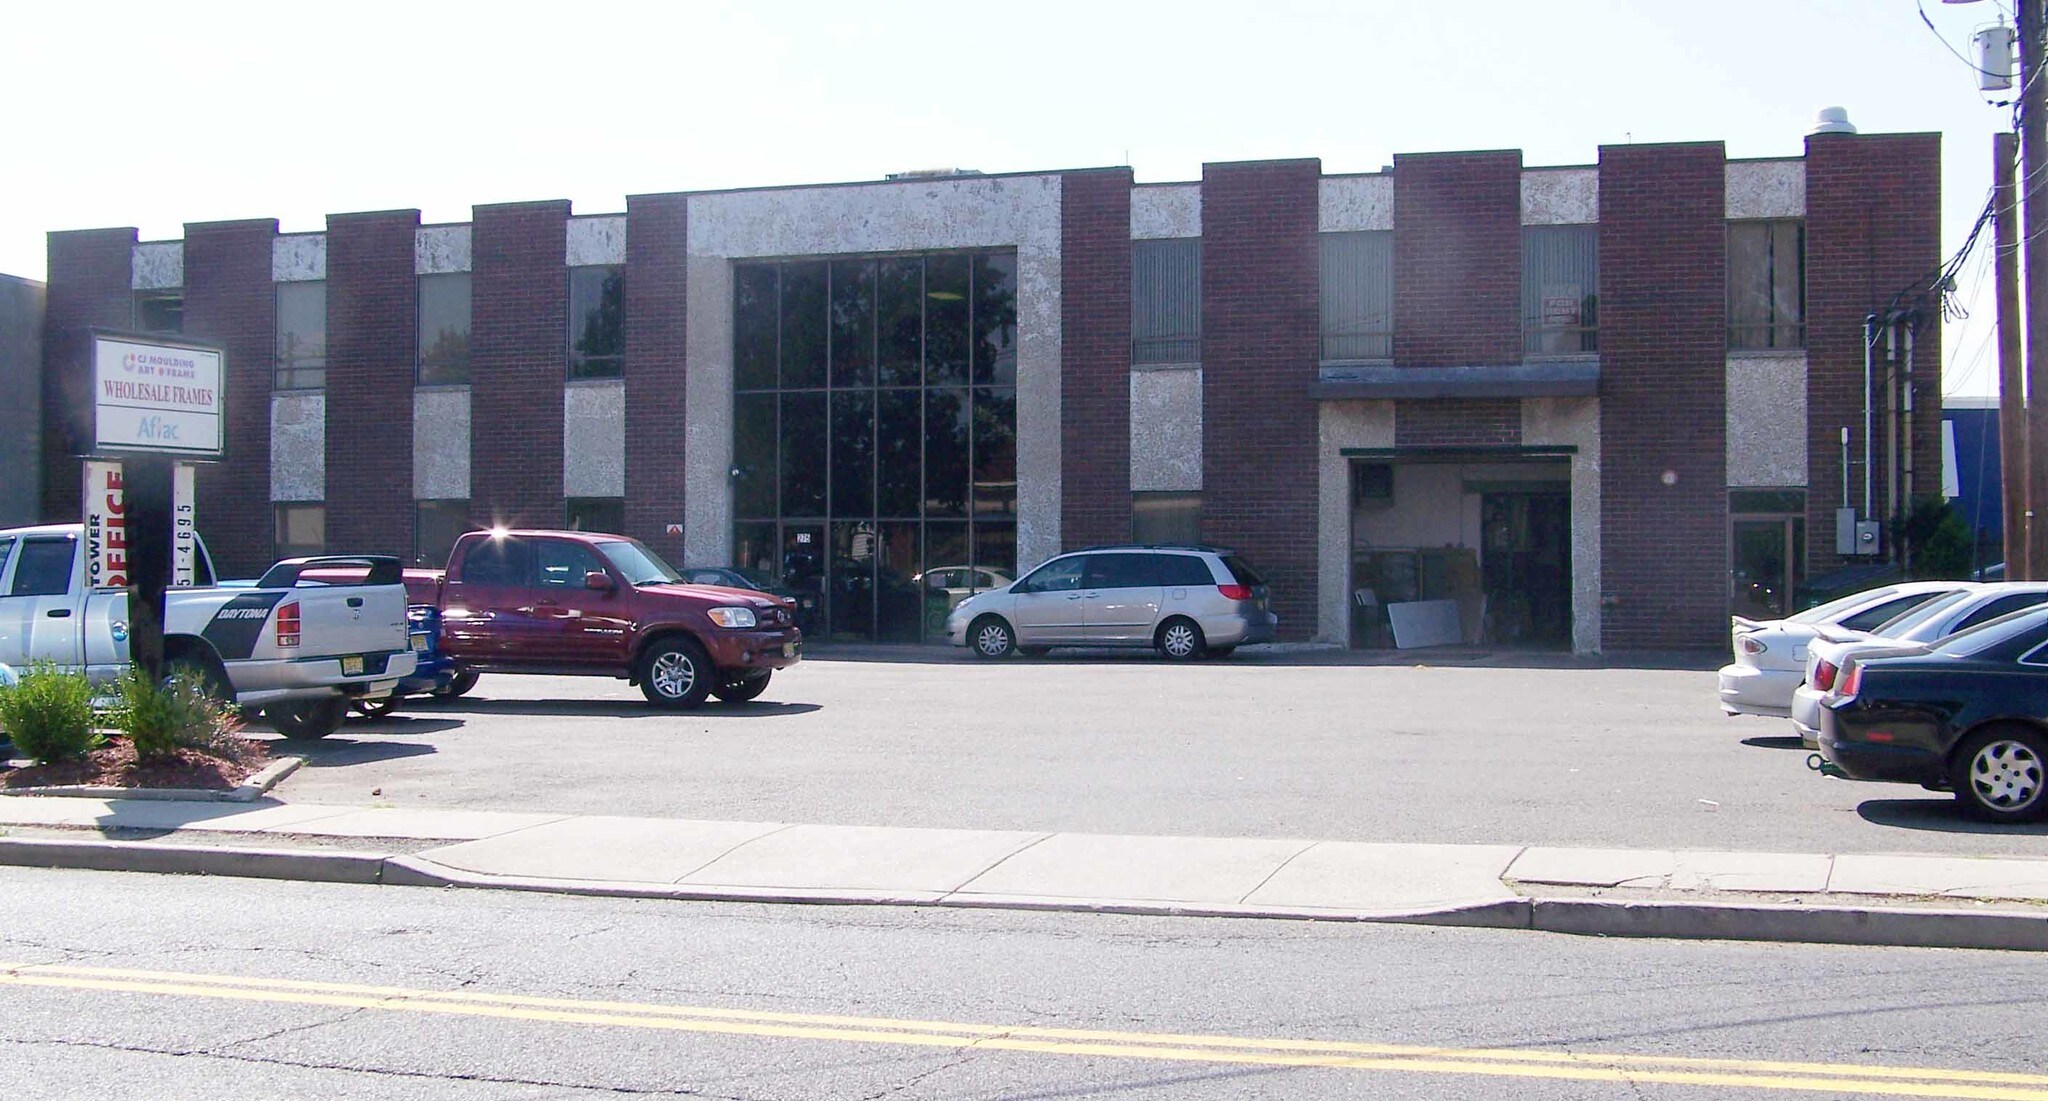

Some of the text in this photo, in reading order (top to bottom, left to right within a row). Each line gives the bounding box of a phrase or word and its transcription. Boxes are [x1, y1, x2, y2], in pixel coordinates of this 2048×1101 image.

[137, 355, 147, 363] CJ
[149, 355, 194, 368] MOULDING
[138, 366, 195, 379] ART FRAME
[104, 380, 213, 406] WHOLESALE FRAMES
[138, 415, 178, 440] Aflac
[90, 514, 100, 587] TOWER
[217, 609, 269, 619] DAYTONA
